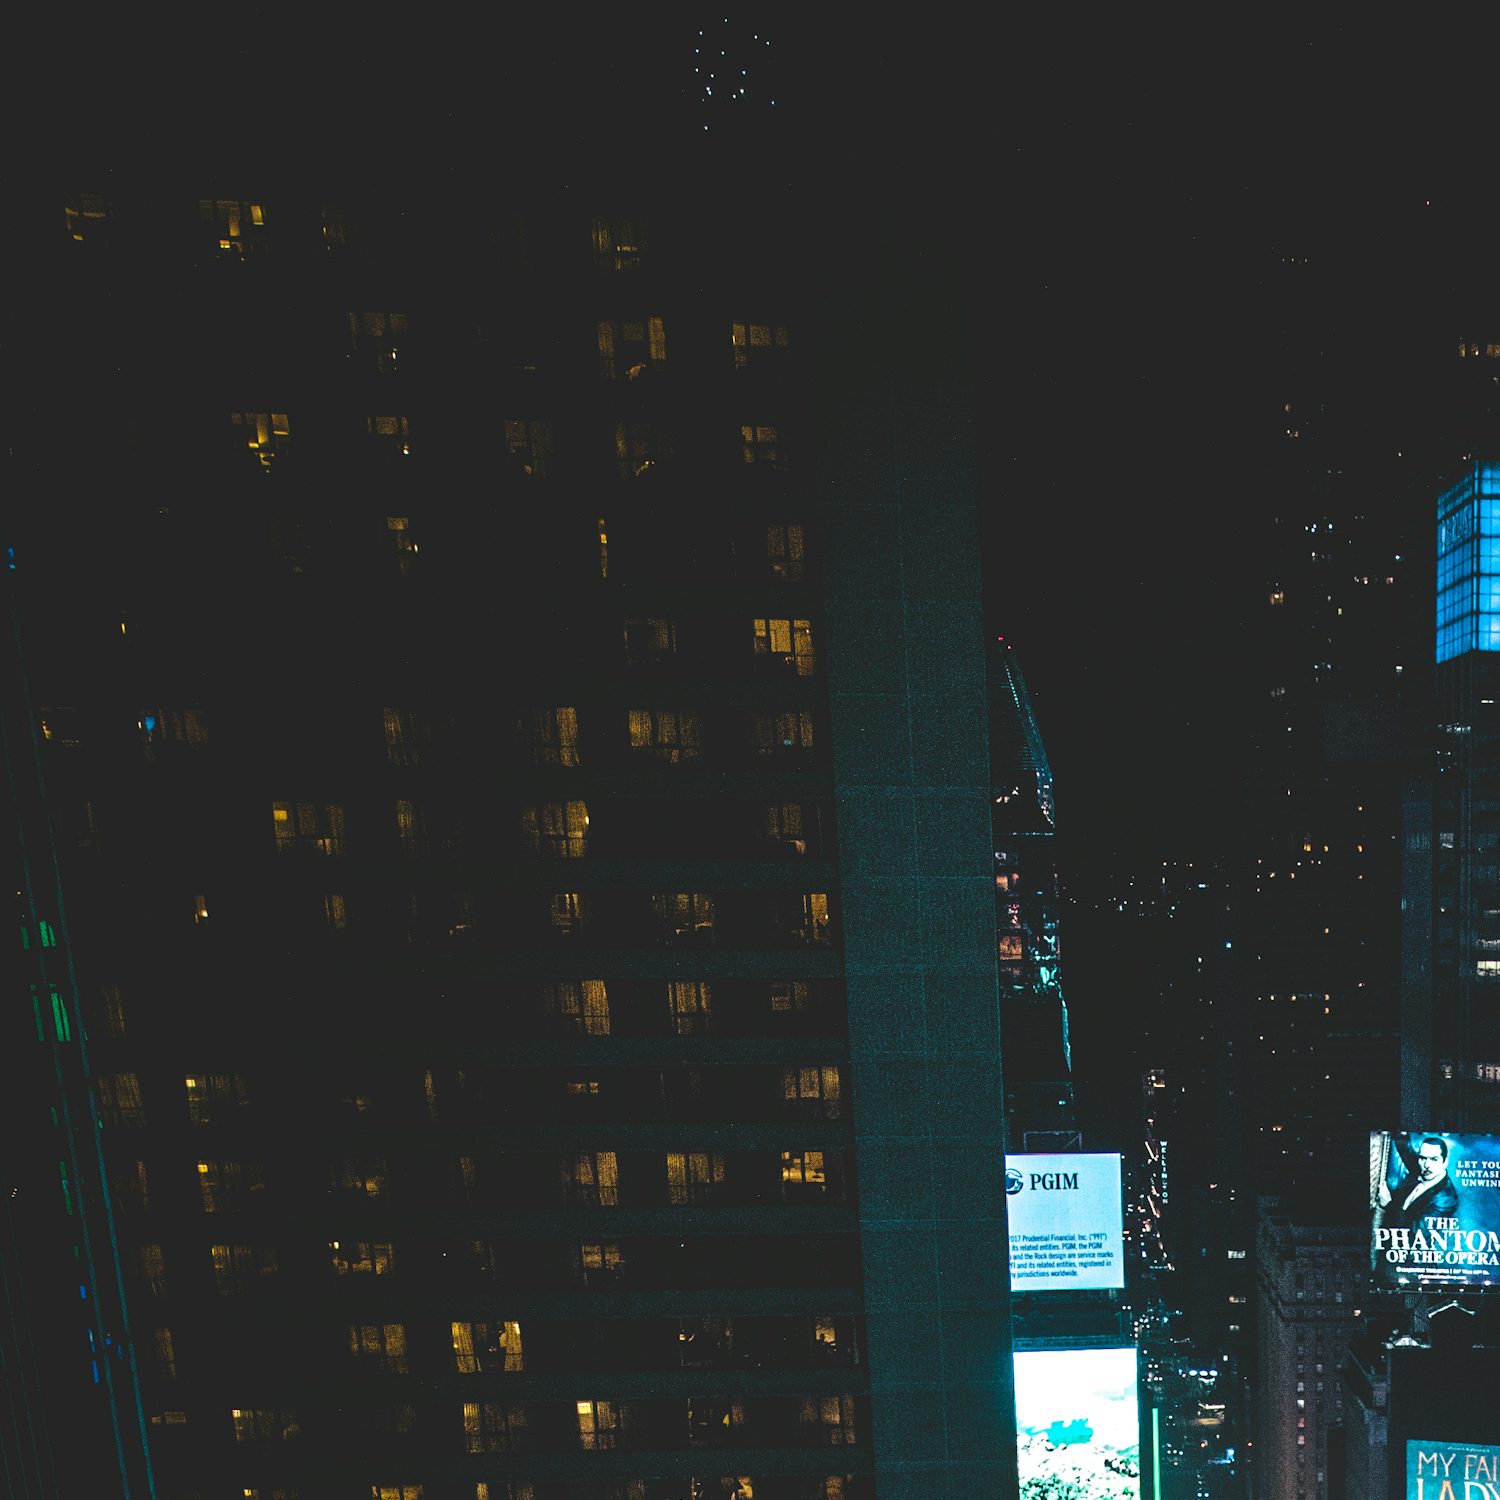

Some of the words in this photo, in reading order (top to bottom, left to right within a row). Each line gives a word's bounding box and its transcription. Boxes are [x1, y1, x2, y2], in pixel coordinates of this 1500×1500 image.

[1457, 1160, 1478, 1169] LET
[1030, 1172, 1079, 1191] PGIM
[1425, 1217, 1459, 1230] THE
[1385, 1250, 1408, 1263] OF
[1410, 1250, 1444, 1263] THE
[1445, 1251, 1500, 1266] OPERA
[1417, 1450, 1456, 1477] MY
